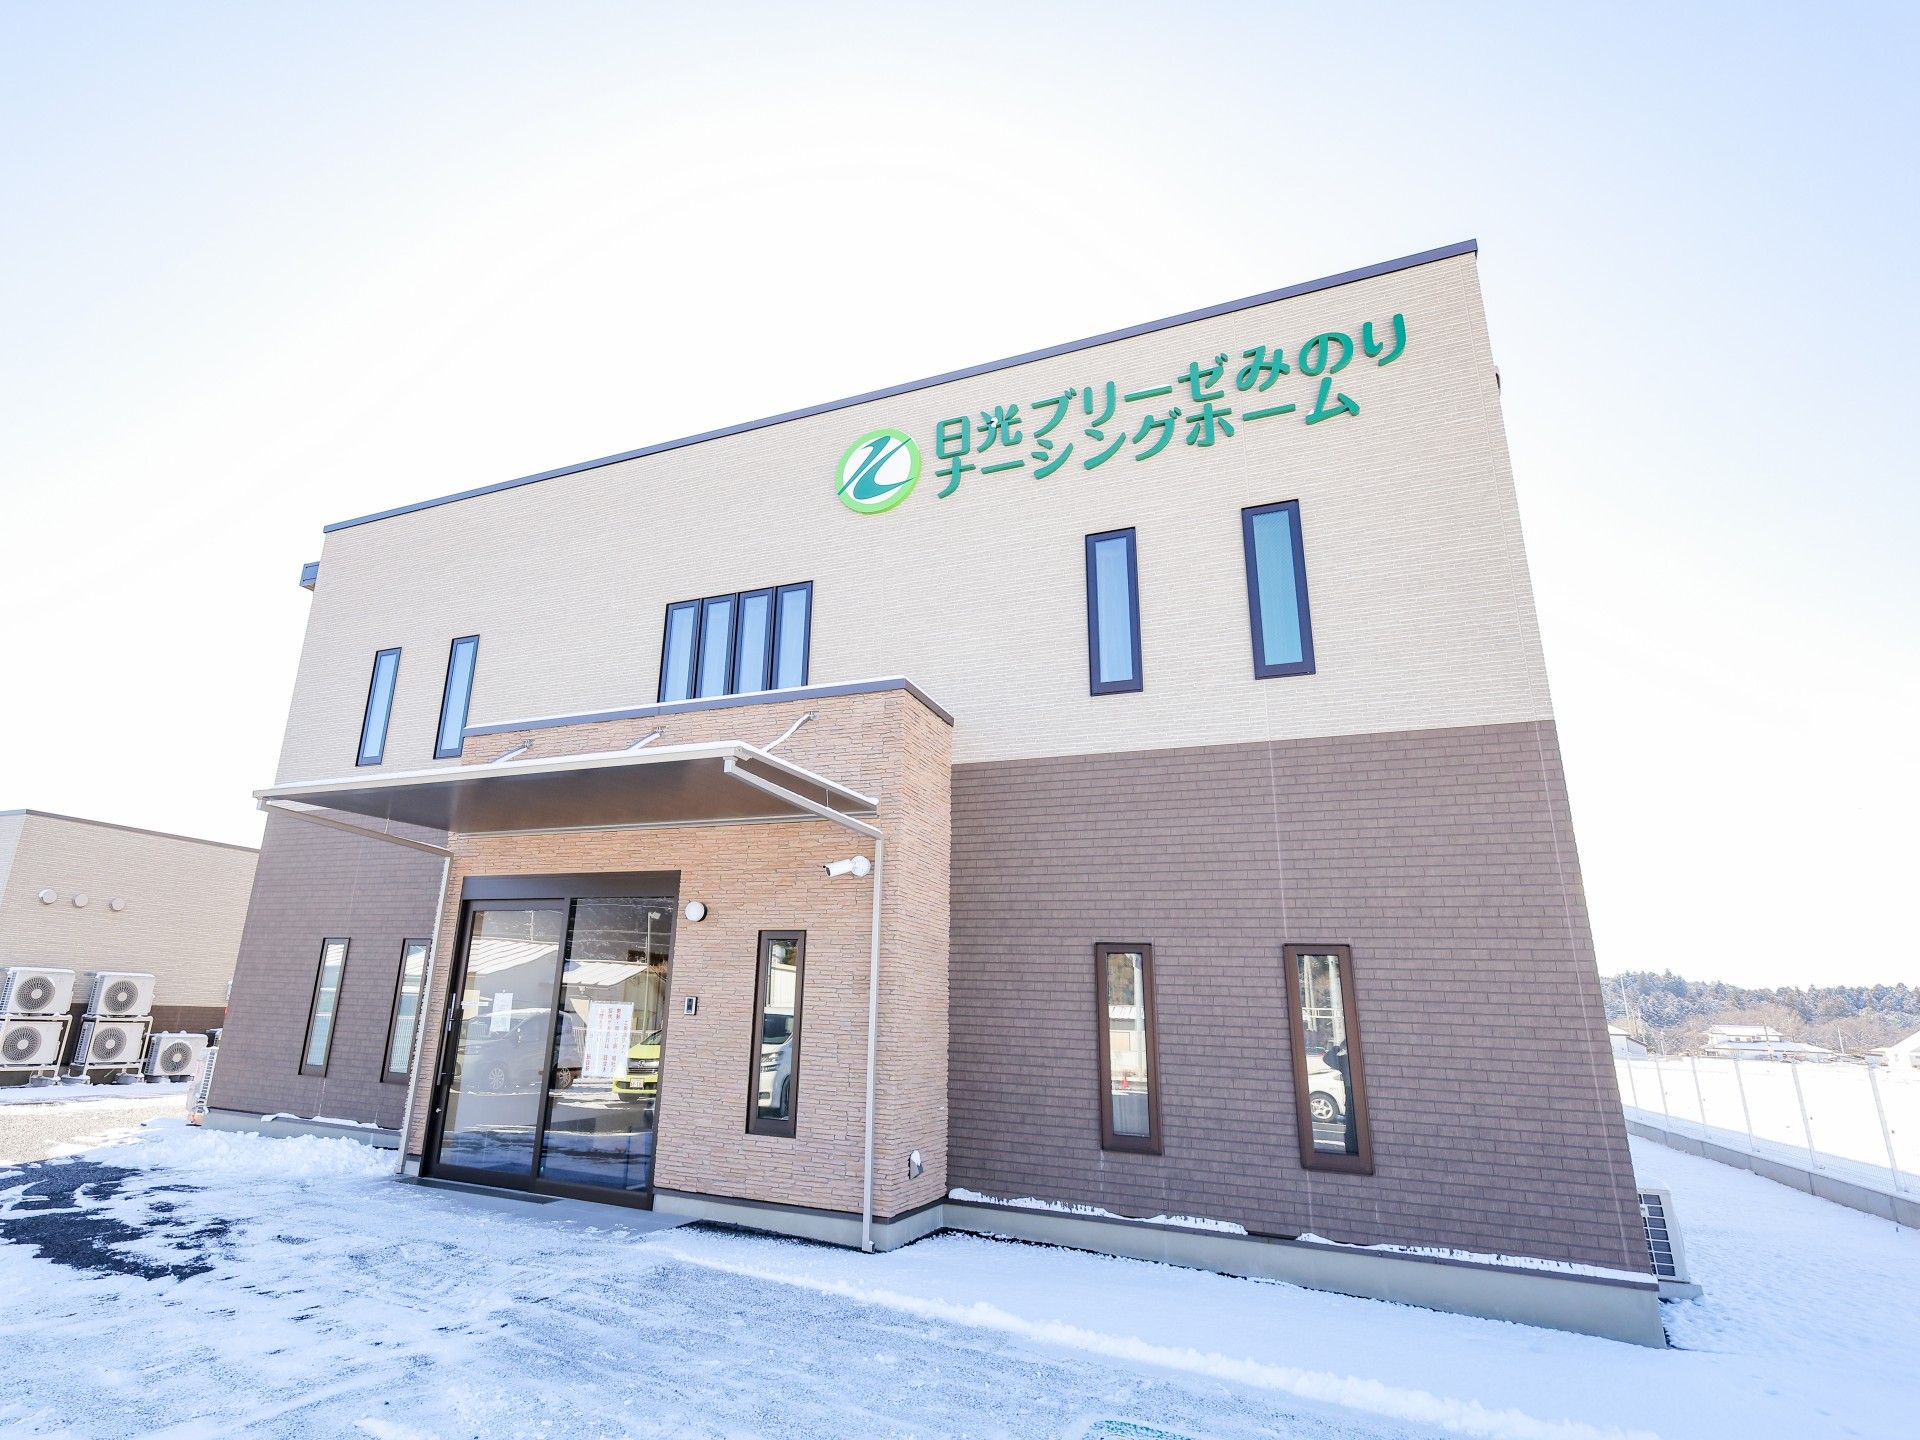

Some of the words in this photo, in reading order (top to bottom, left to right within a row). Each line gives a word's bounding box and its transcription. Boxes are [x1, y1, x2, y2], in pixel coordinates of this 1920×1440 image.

[935, 313, 1407, 459] 日光ブリーゼみのり
[935, 376, 1361, 500] ナーシングホーム
